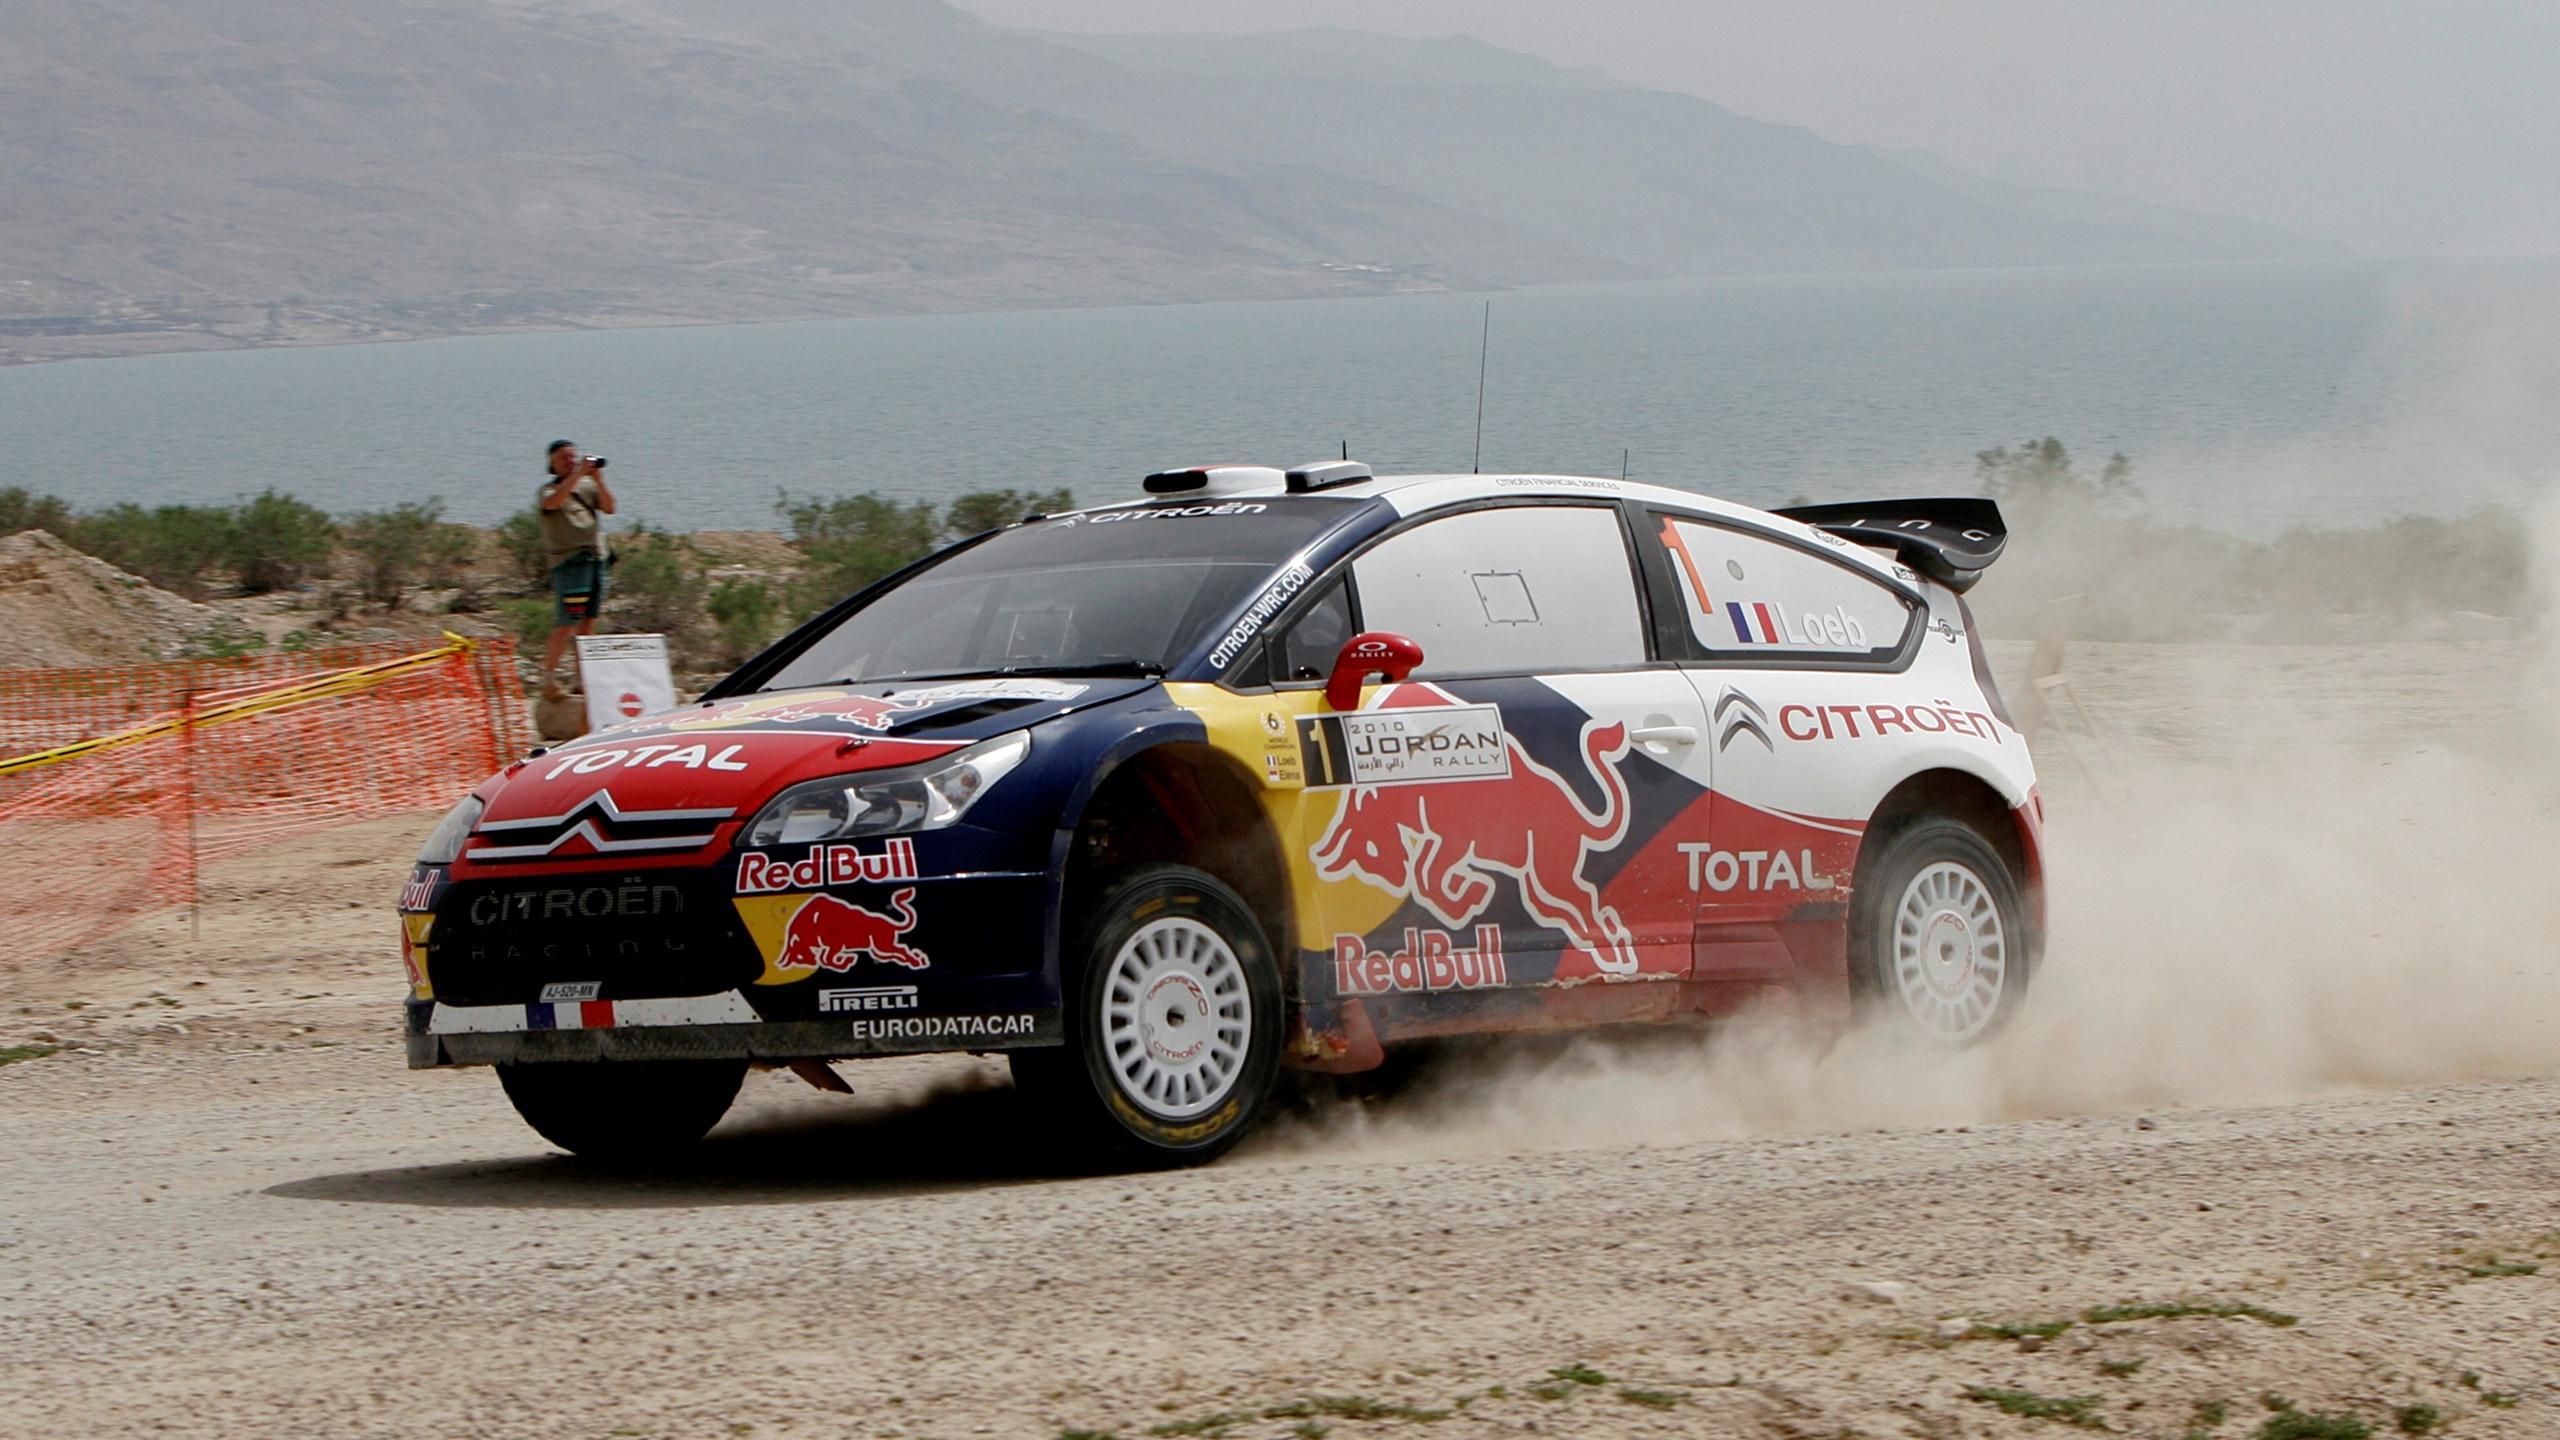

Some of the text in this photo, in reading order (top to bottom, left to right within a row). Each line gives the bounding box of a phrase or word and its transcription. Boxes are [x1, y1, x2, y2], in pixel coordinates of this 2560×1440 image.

[1090, 502, 1267, 523] CITROËN
[1659, 517, 1713, 614] 1
[1209, 562, 1314, 669] CITROEN-WRC.COM
[1775, 602, 1867, 647] Loeb
[1268, 712, 1279, 729] 6
[1351, 721, 1405, 735] 2010
[1779, 698, 2002, 745] CITROËN
[545, 744, 748, 781] TOTAL
[1309, 719, 1334, 784] 1
[1355, 731, 1499, 756] JORDAN
[1433, 754, 1501, 767] RALLY
[736, 837, 919, 893] Red Bull
[1677, 842, 1835, 892] TOTAL
[471, 876, 684, 926] CITROËN
[1335, 923, 1507, 995] Red Bull
[544, 984, 595, 998] AJ-520-MN
[819, 986, 918, 1011] PIRELLI
[852, 1015, 1035, 1040] EURODATACAR
